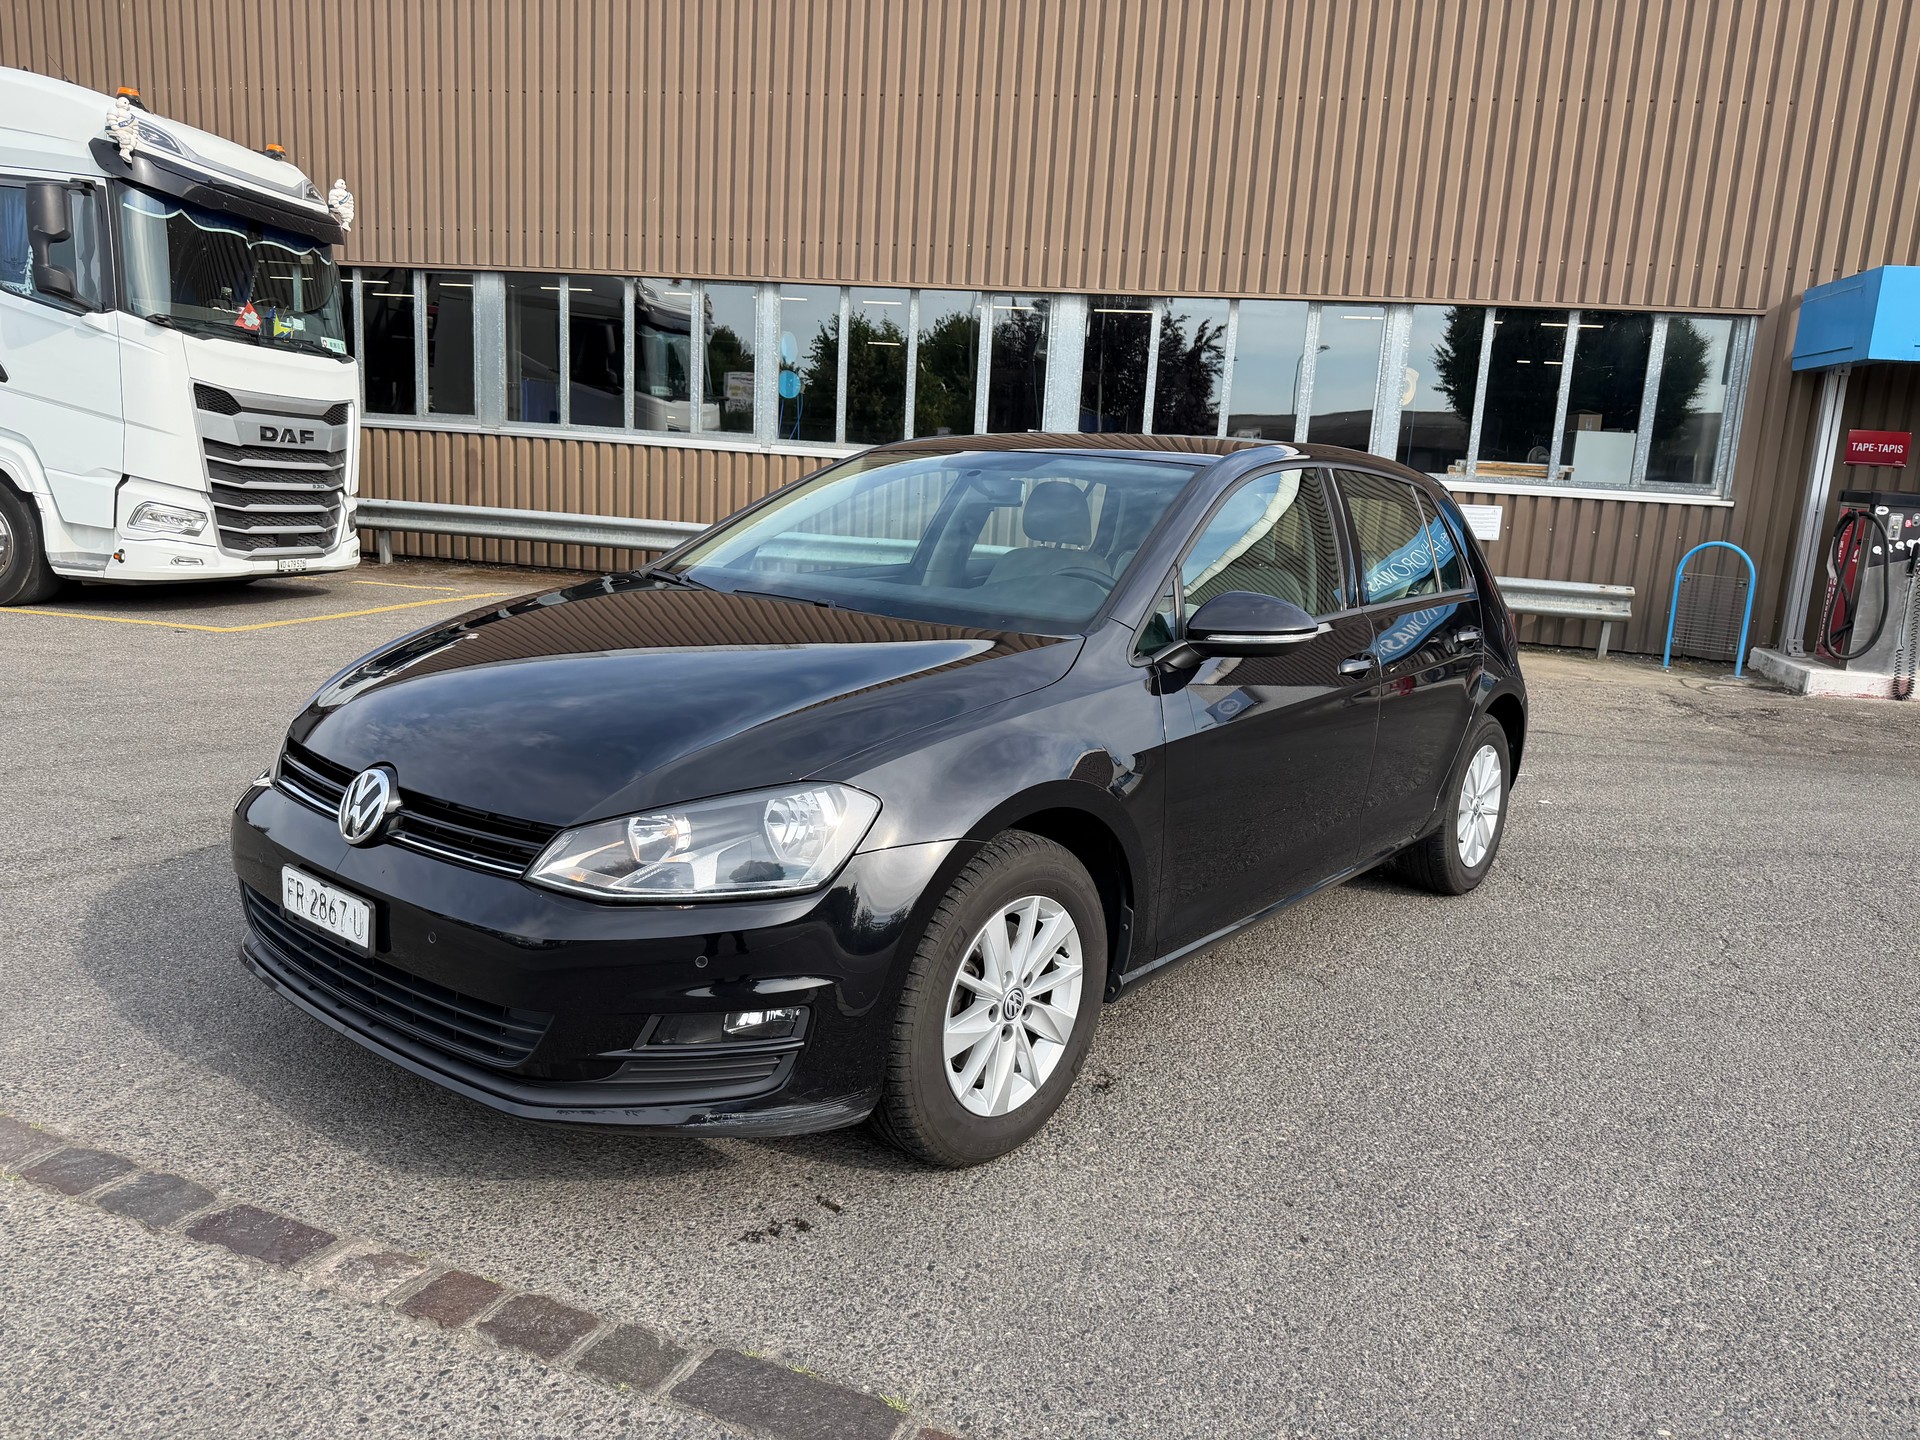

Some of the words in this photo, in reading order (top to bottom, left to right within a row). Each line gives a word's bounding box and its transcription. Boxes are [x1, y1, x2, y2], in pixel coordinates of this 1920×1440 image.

[260, 426, 314, 444] DAF
[1852, 442, 1904, 454] TAPE-TAPIS
[287, 875, 305, 914] FR
[310, 886, 348, 933] 2867
[353, 904, 364, 940] U
